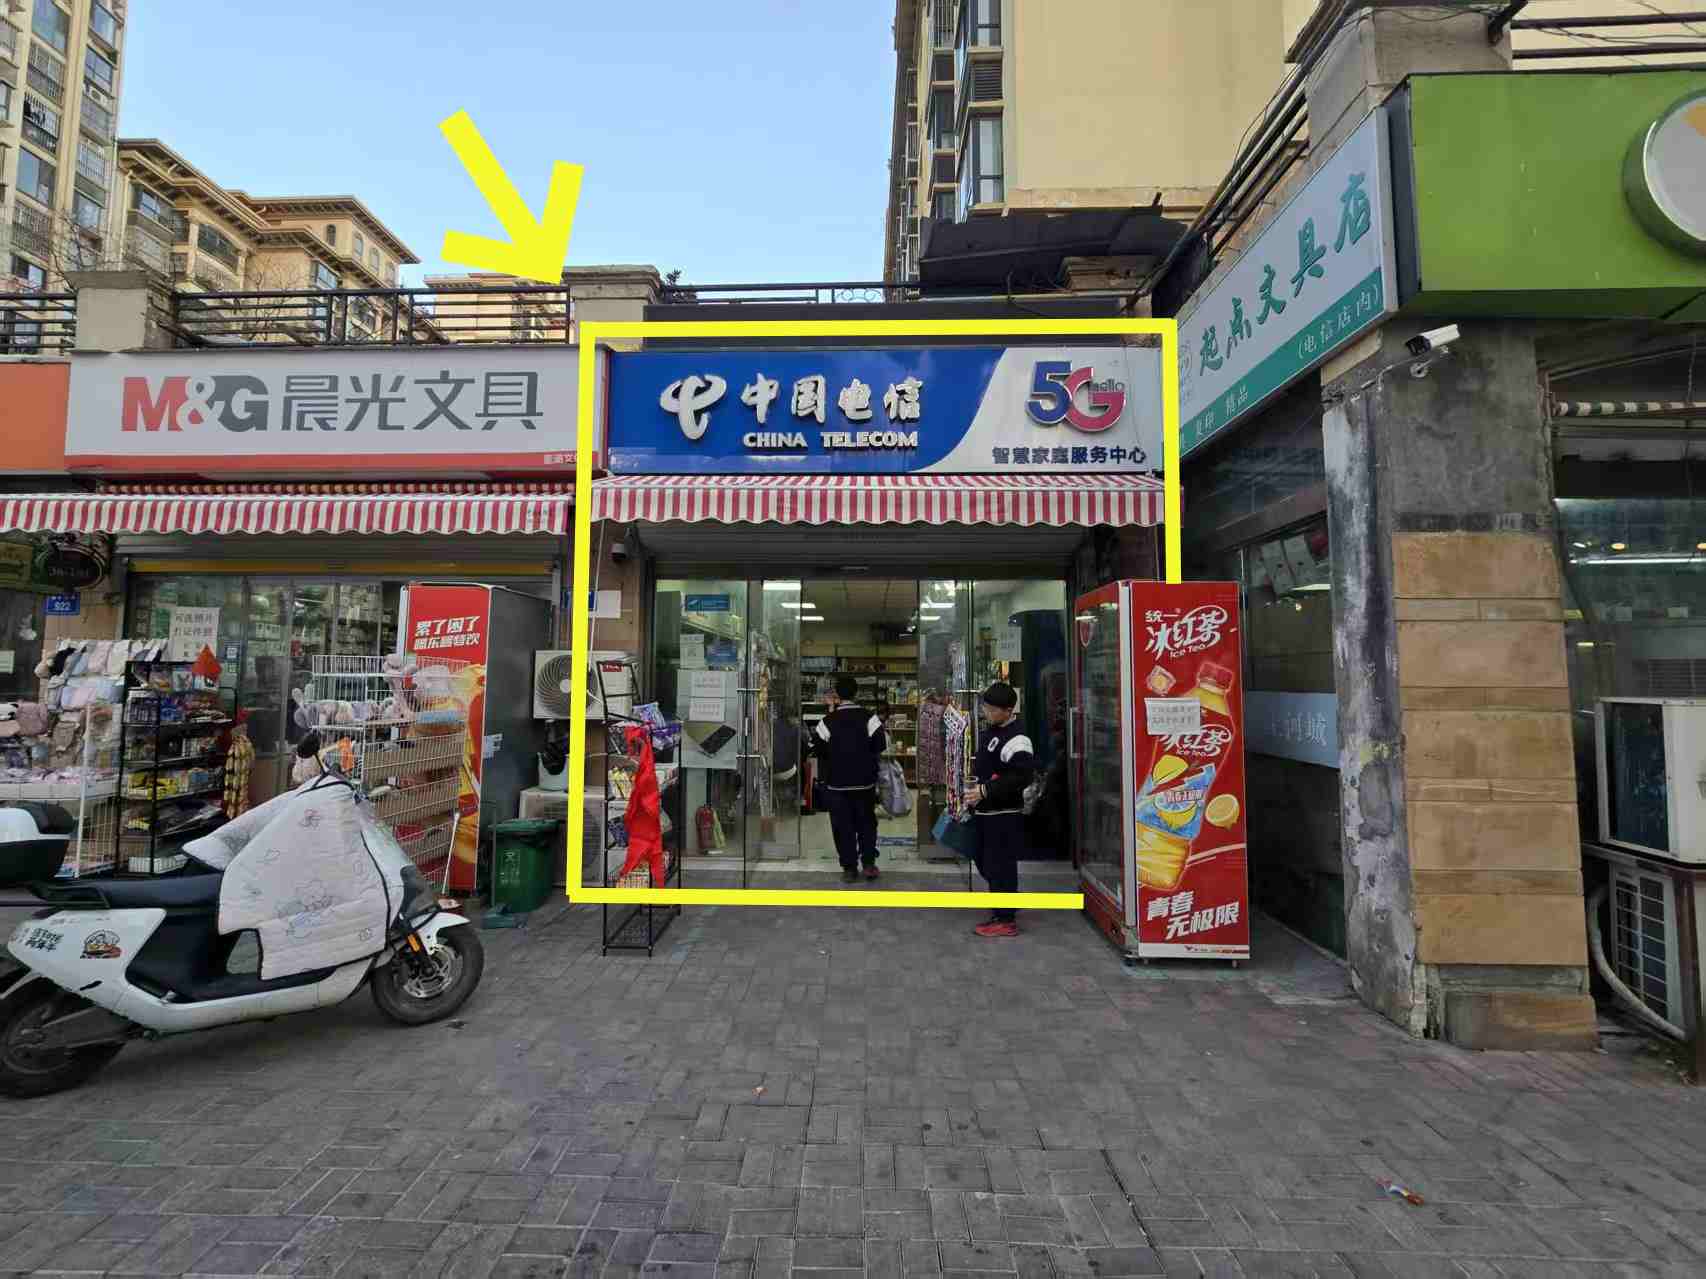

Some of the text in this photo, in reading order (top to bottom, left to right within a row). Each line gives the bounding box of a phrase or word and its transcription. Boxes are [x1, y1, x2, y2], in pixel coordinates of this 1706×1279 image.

[1200, 172, 1371, 376] 起点文具店
[120, 375, 269, 432] M&G
[281, 369, 544, 432] 晨光文具
[741, 373, 924, 424] 中国电信
[1025, 360, 1127, 432] 5G
[742, 431, 919, 448] CHINA TELECOM
[991, 446, 1147, 465] 智慧家庭服务中心
[414, 615, 481, 637] 累了困了
[1144, 604, 1229, 661] 冰红茶
[1145, 609, 1179, 623] 统一
[1146, 890, 1194, 921] 青春
[1164, 901, 1240, 940] 无极限
